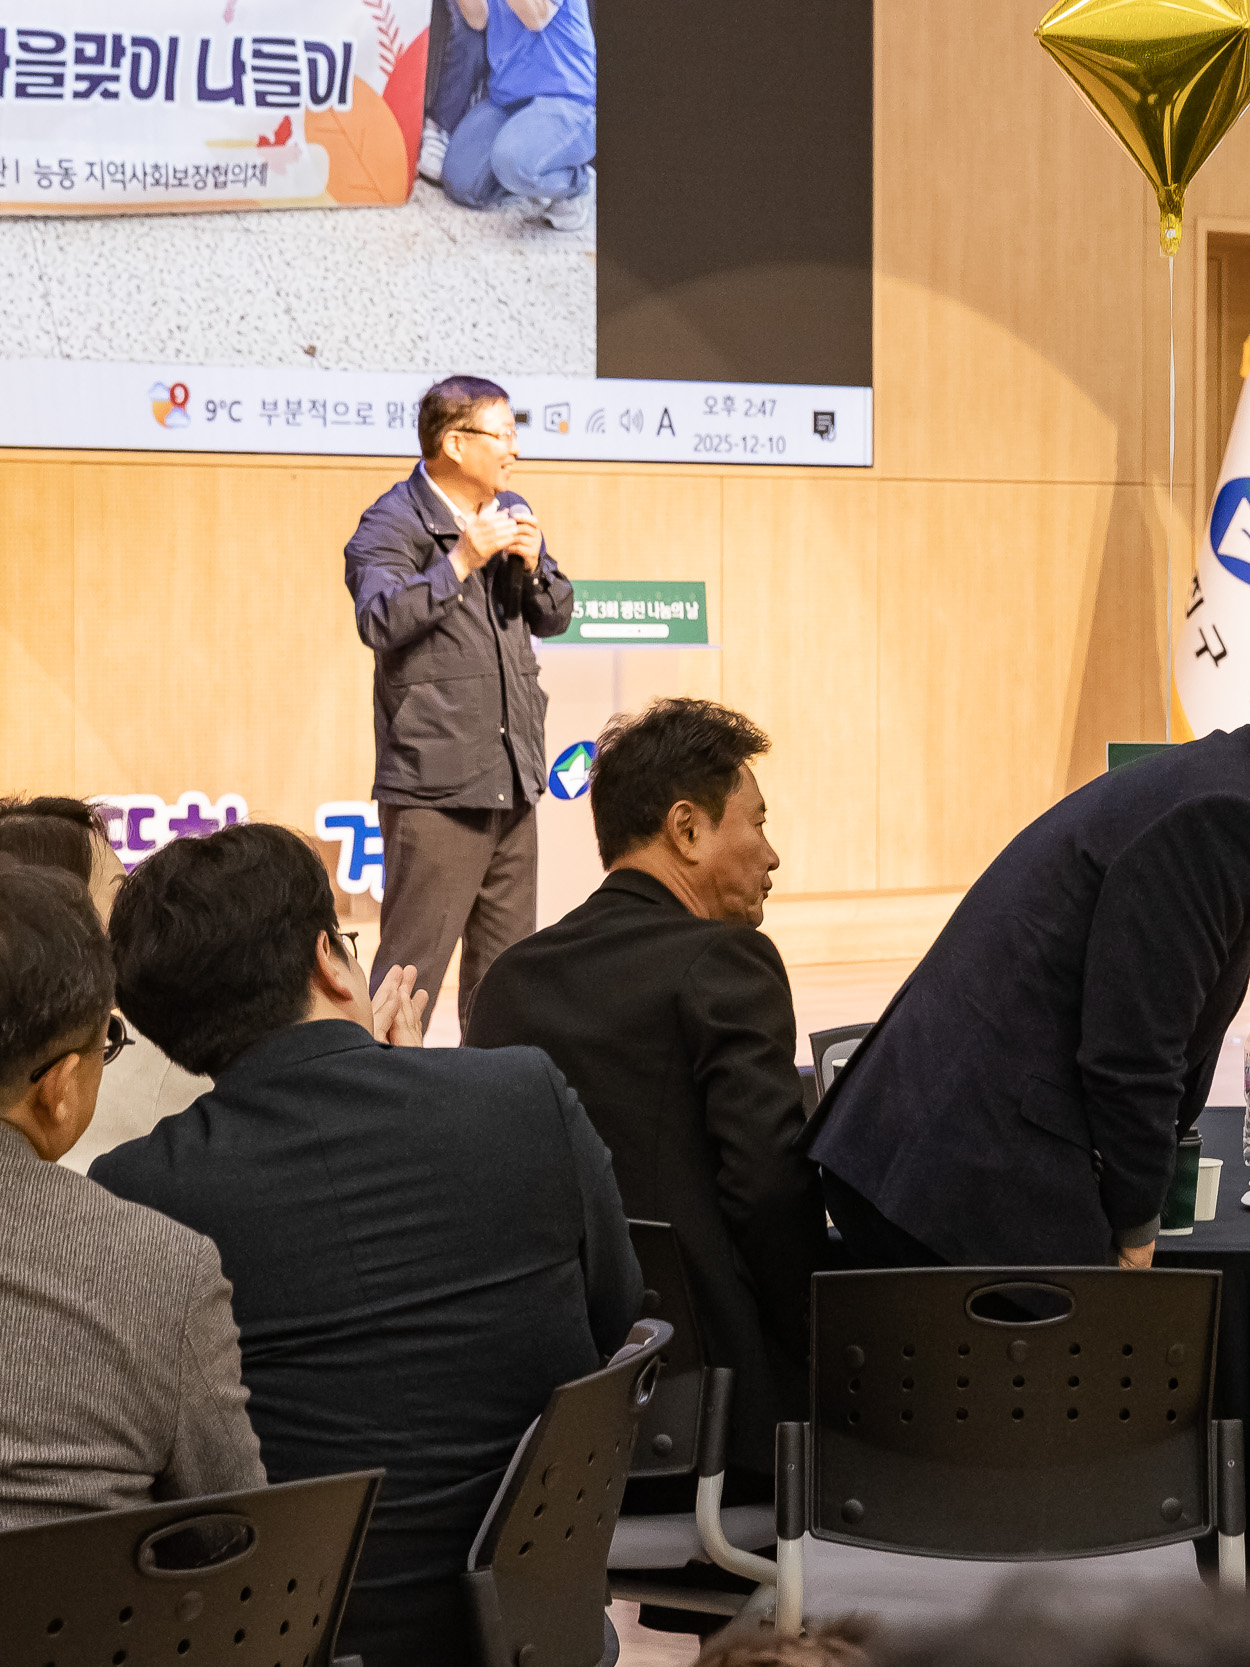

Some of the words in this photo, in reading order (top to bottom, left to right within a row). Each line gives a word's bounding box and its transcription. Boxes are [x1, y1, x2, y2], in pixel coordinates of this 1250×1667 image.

[197, 36, 353, 109] 나들이
[34, 158, 77, 190] 능동
[85, 160, 269, 191] 지역사회보장협의체
[204, 399, 242, 422] 9°C
[259, 398, 375, 428] 부분적으로
[656, 407, 676, 436] A
[702, 396, 736, 417] 오후
[743, 398, 778, 418] 2:47
[693, 434, 787, 455] 2025-12-10
[647, 600, 685, 620] 나눔의
[685, 600, 700, 620] 날
